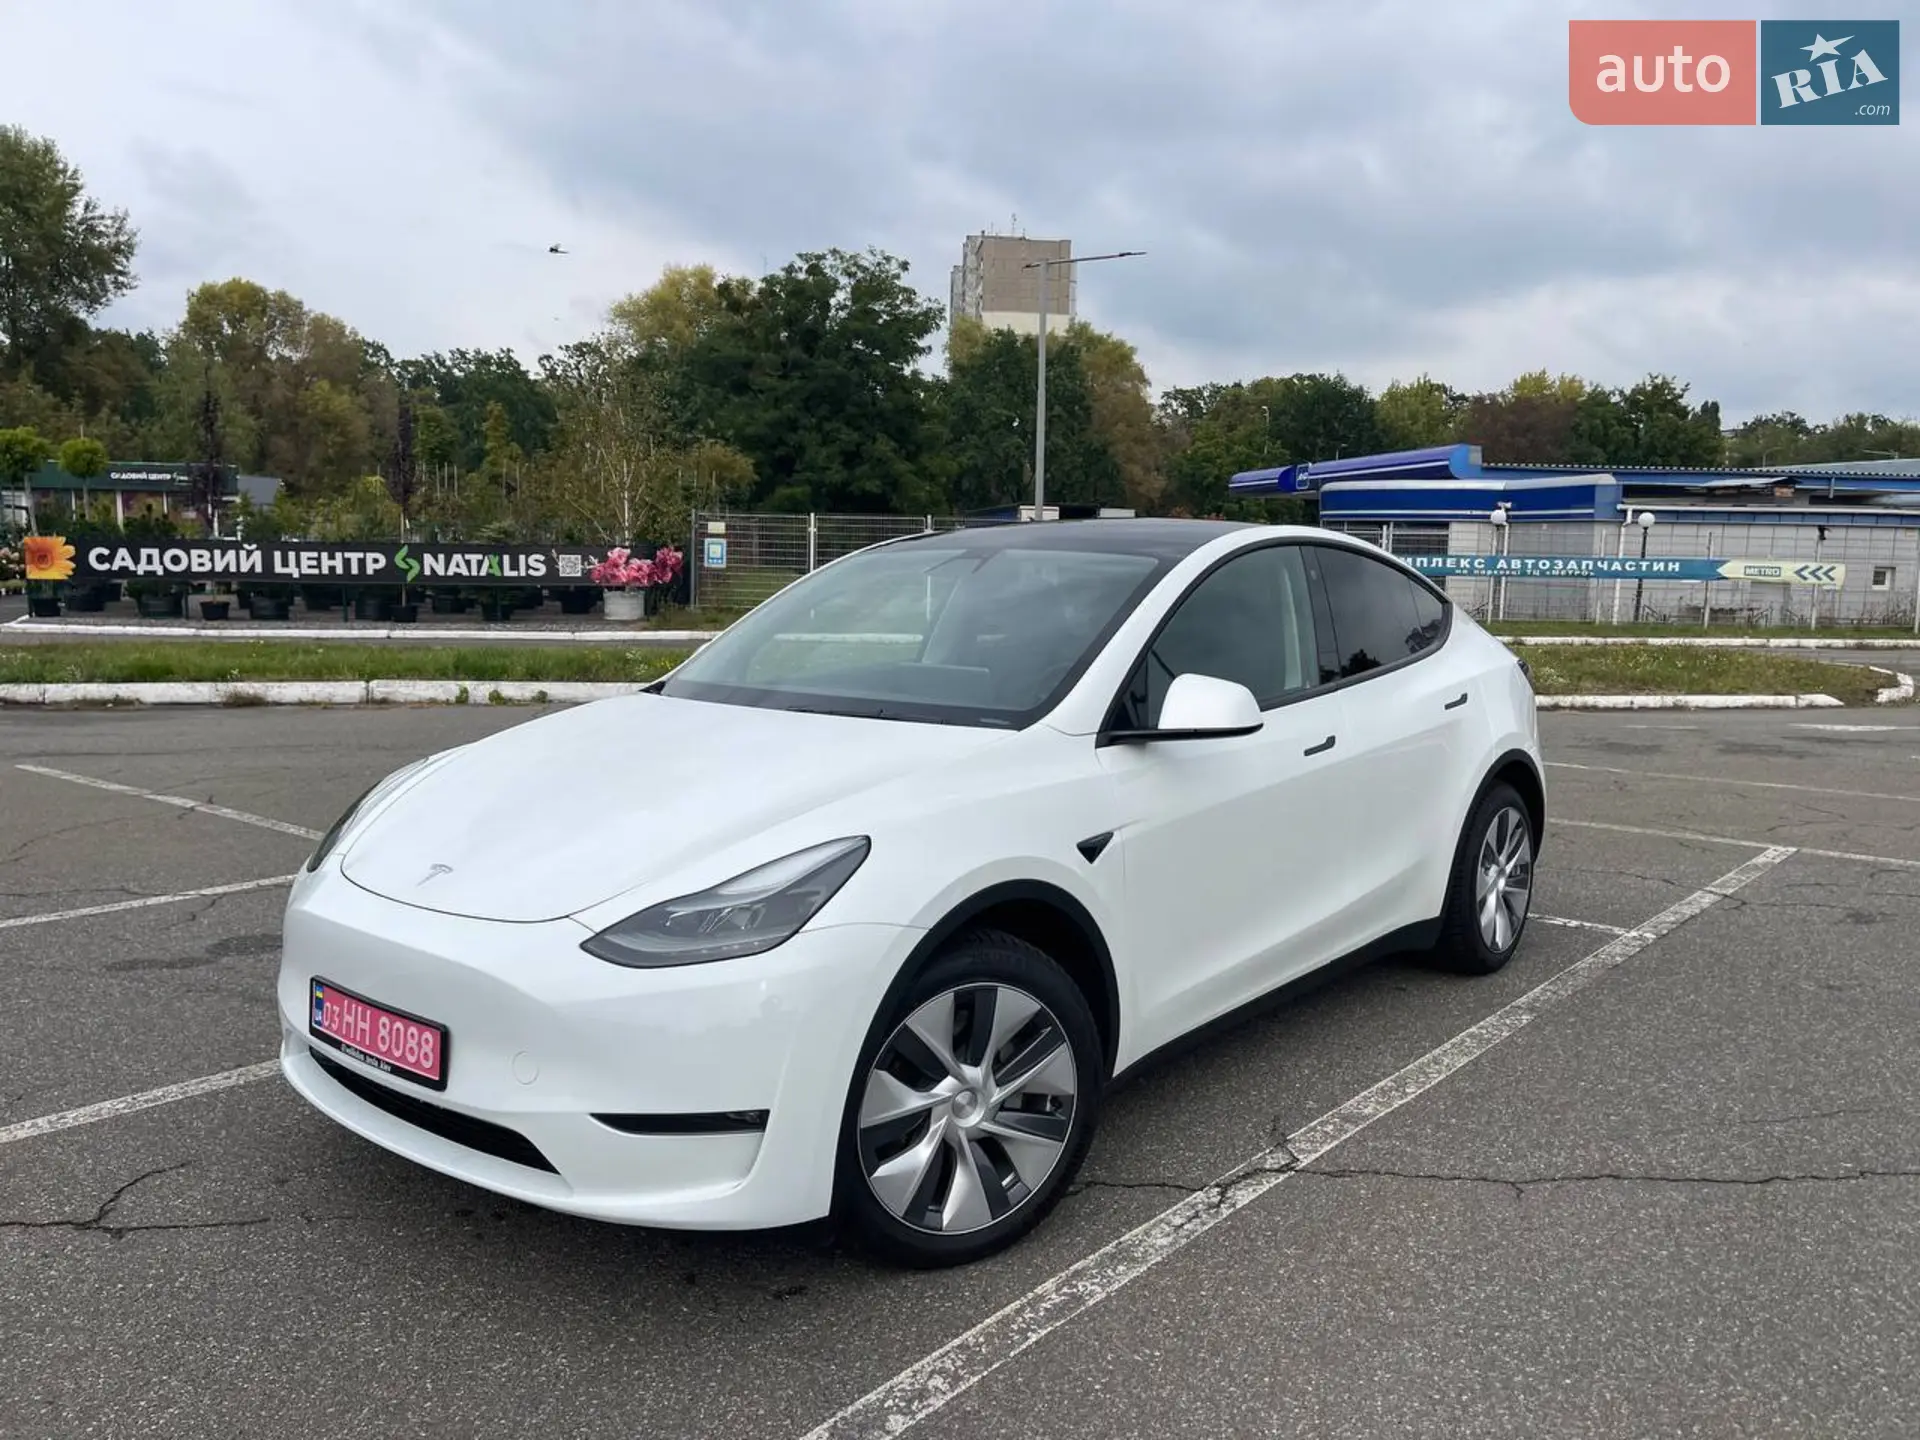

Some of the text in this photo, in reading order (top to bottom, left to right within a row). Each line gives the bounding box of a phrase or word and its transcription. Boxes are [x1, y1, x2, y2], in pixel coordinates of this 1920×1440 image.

[88, 544, 386, 578] САДОВИЙ ЦЕНТР
[423, 553, 547, 577] NATALIS
[1401, 557, 1681, 572] МПЛЕКС АВТОЗАПЧАСТИН
[1745, 567, 1780, 576] METRO
[377, 1015, 434, 1069] 8088
